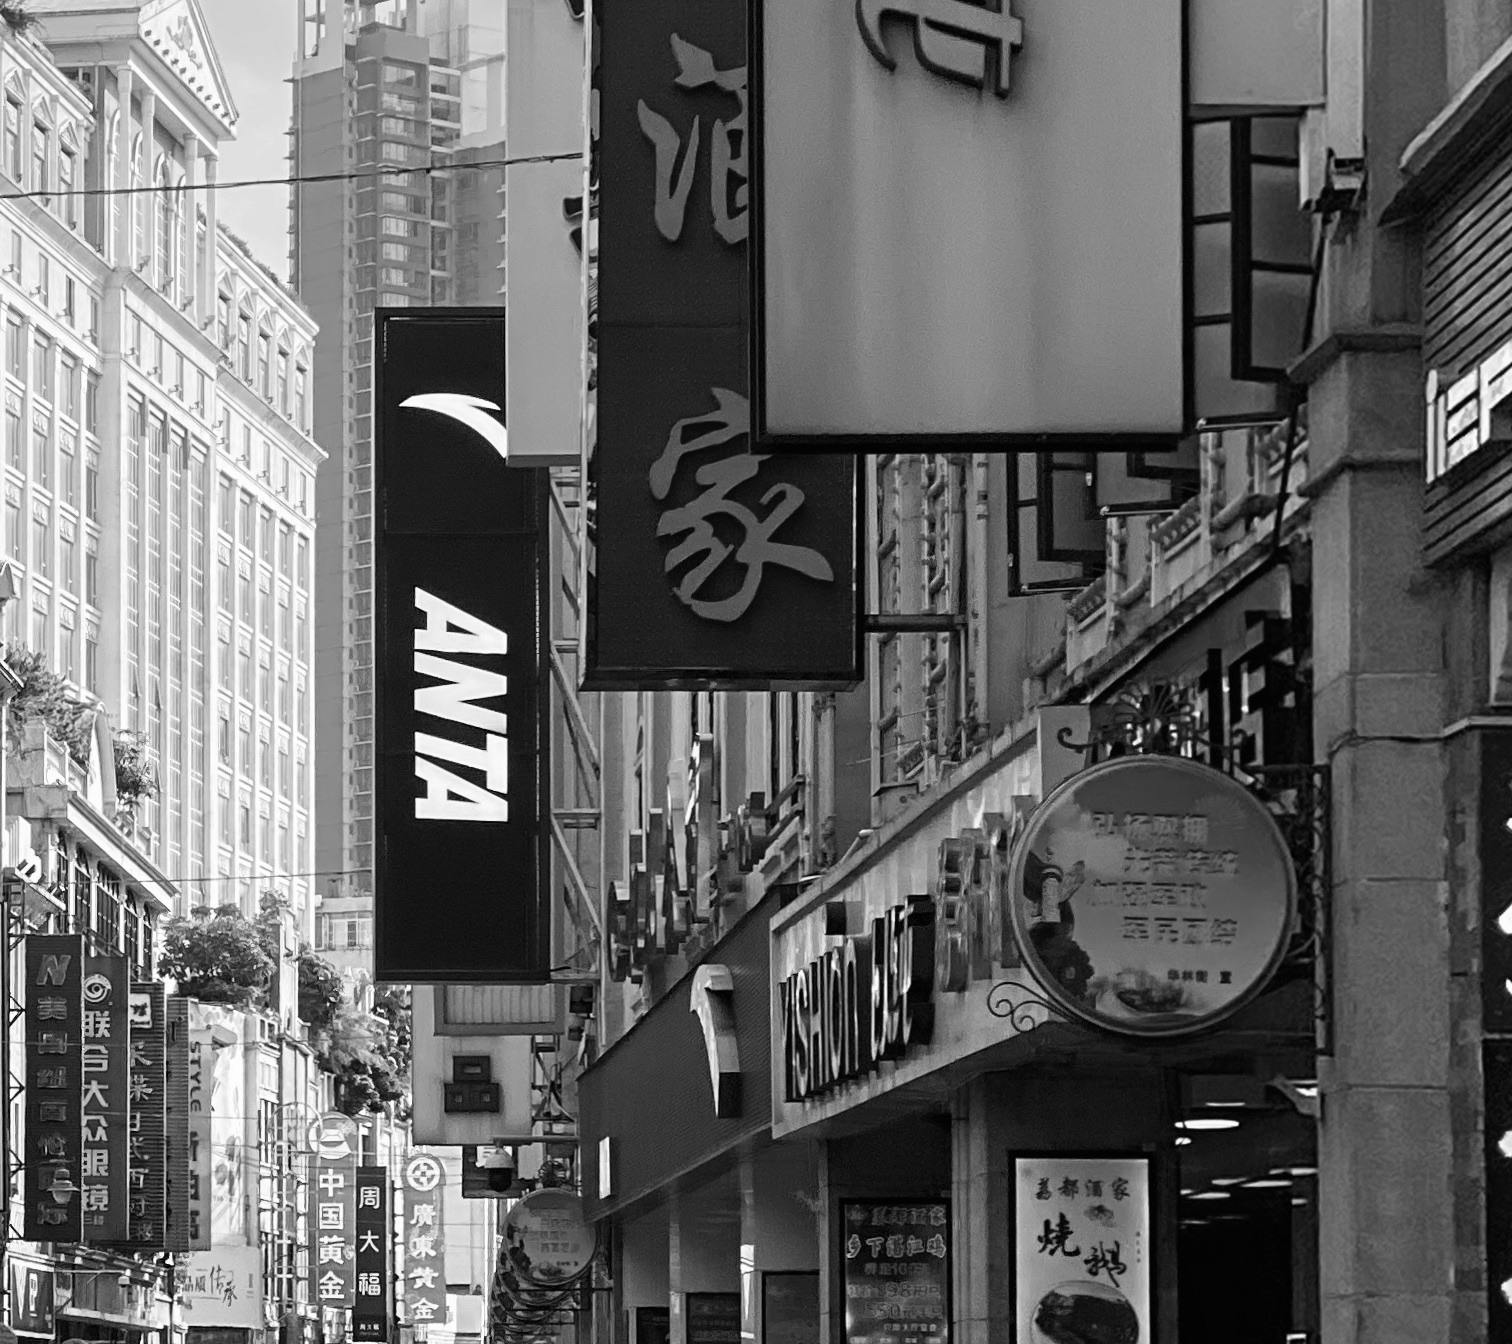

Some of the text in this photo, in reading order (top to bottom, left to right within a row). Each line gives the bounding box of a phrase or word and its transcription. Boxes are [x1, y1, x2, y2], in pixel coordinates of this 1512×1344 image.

[413, 586, 509, 822] ANTA
[319, 1168, 346, 1300] 中国黄金
[358, 1186, 381, 1296] 周大福
